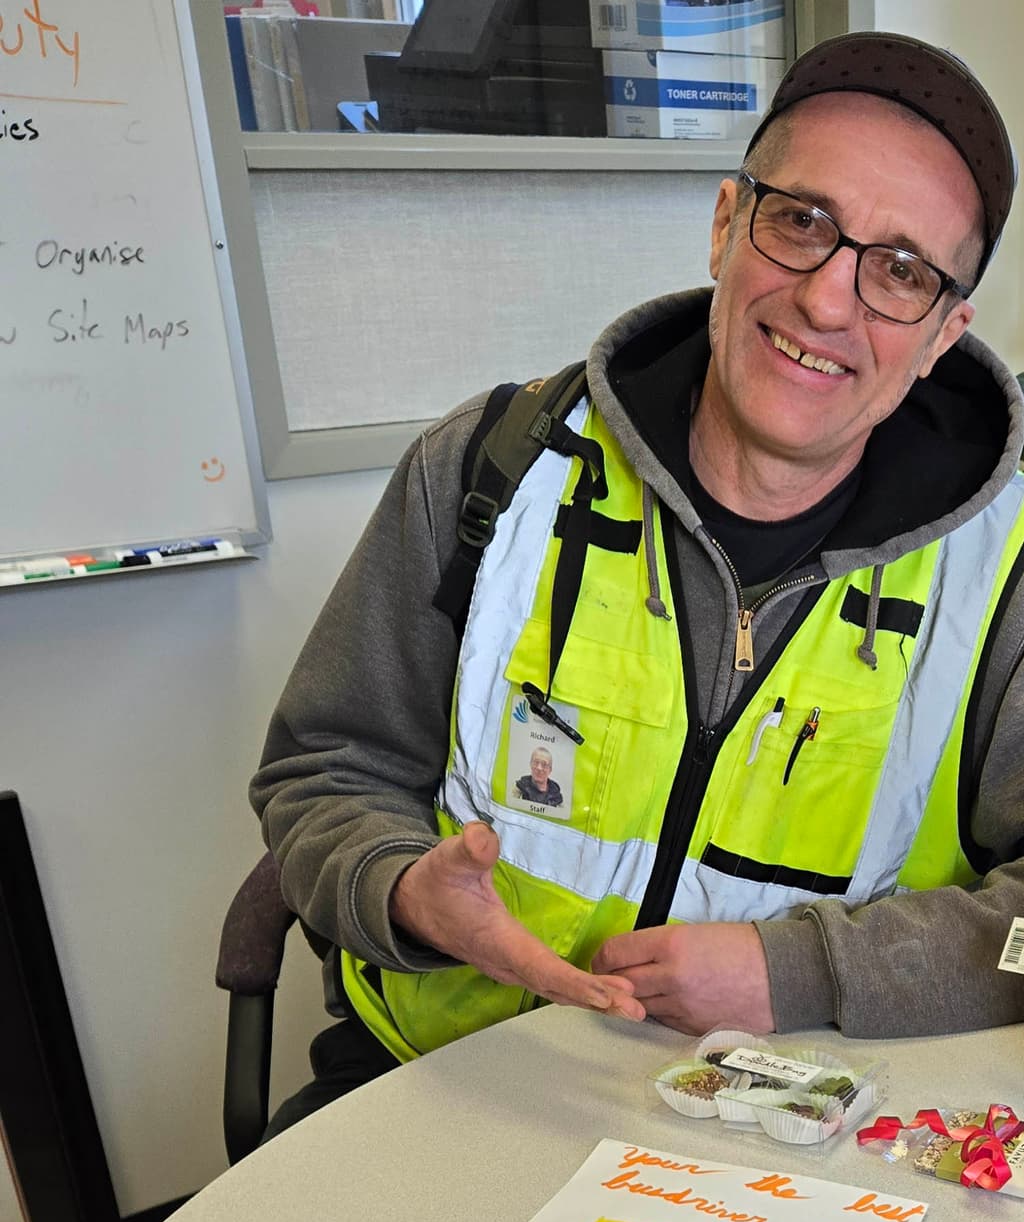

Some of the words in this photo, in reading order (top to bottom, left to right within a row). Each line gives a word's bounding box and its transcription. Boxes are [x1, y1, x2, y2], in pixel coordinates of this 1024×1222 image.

[666, 88, 698, 101] TONER
[699, 90, 750, 103] CARTRIDGE
[35, 240, 145, 276] Organise
[47, 298, 103, 343] Site
[124, 312, 190, 351] Maps
[530, 731, 556, 744] Richard
[529, 805, 545, 814] Staff
[744, 1174, 814, 1200] the
